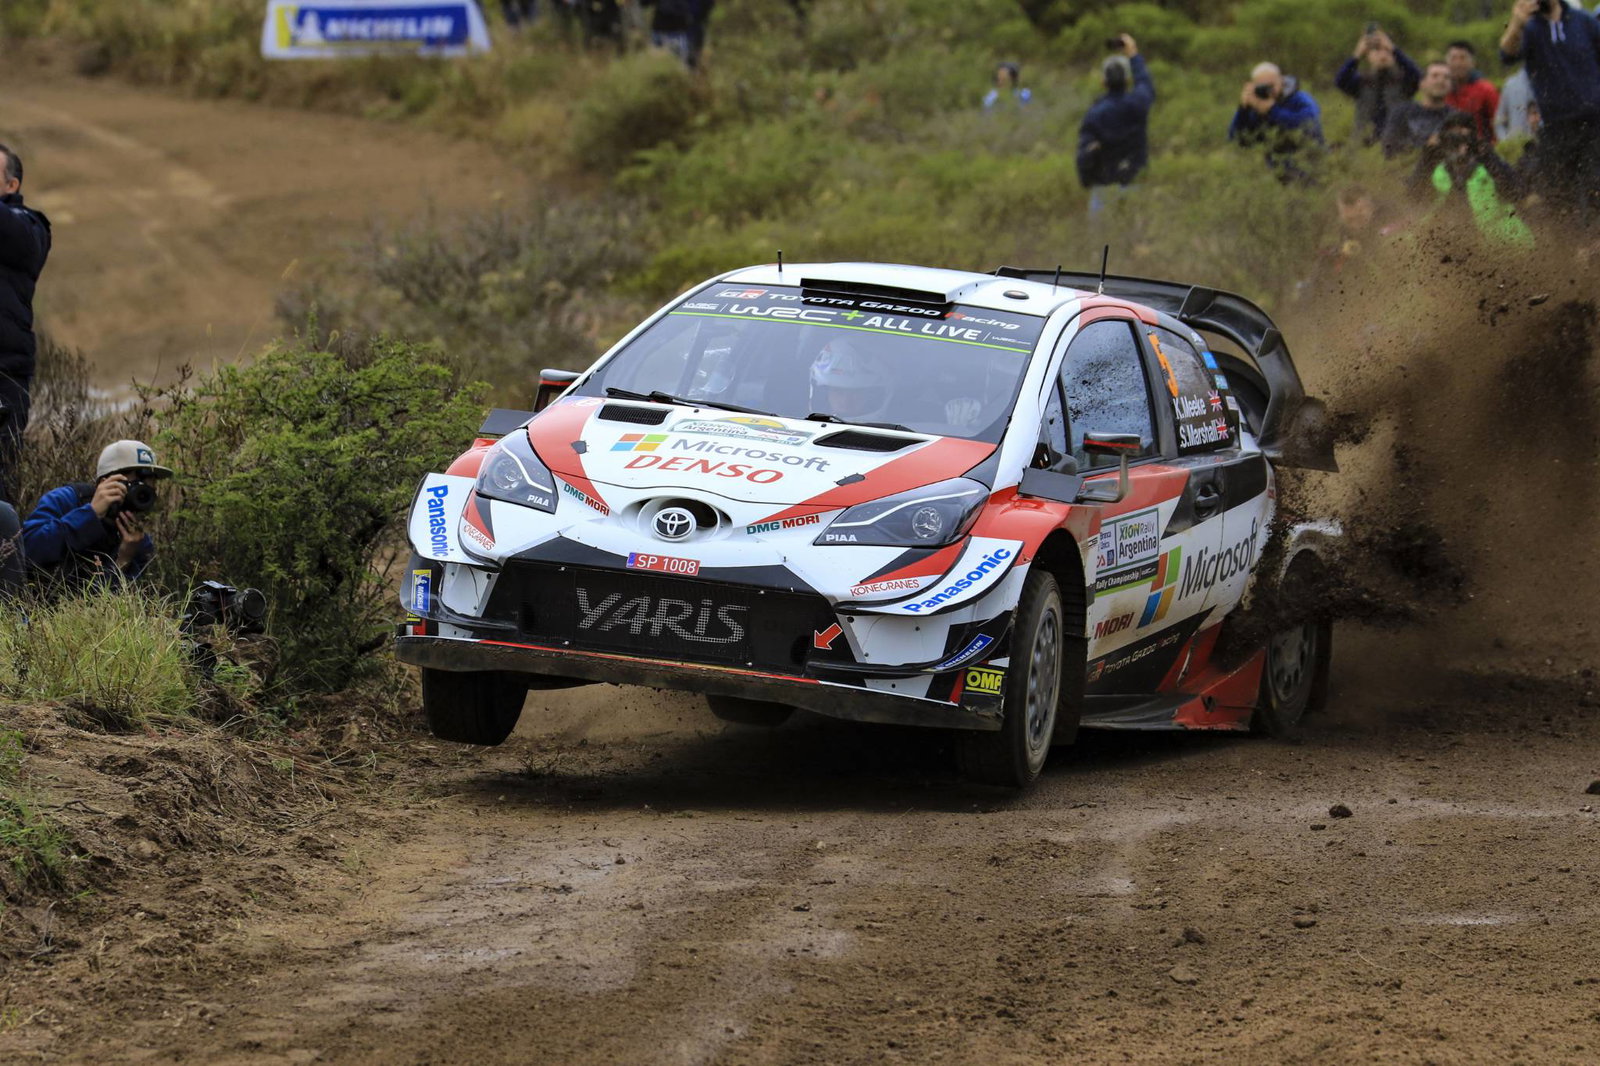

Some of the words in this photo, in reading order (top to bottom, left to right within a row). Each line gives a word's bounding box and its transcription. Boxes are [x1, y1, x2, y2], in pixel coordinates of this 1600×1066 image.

[769, 293, 855, 306] TOYOTA
[859, 301, 942, 316] GAZOO
[944, 312, 1021, 330] Racing
[863, 316, 913, 332] ALL
[921, 323, 982, 340] LIVE
[682, 425, 748, 435] Argentina
[672, 439, 831, 473] Microsoft
[624, 455, 783, 484] DENSO
[527, 494, 549, 507] PIAA
[563, 483, 585, 502] DMG
[584, 496, 610, 517] MORI
[426, 485, 454, 557] Panasonic
[746, 522, 781, 535] DMG
[782, 514, 820, 529] MORI
[1119, 523, 1140, 541] XION
[826, 533, 857, 542] PIAA
[1119, 535, 1157, 560] Argentina
[637, 555, 658, 568] SP
[663, 558, 697, 574] 1008
[1178, 516, 1258, 601] Microsoft
[851, 579, 920, 597] KONECRANES
[902, 548, 1011, 613] Panasonic
[1094, 612, 1135, 640] MORI
[1105, 655, 1132, 673] TOYOTA
